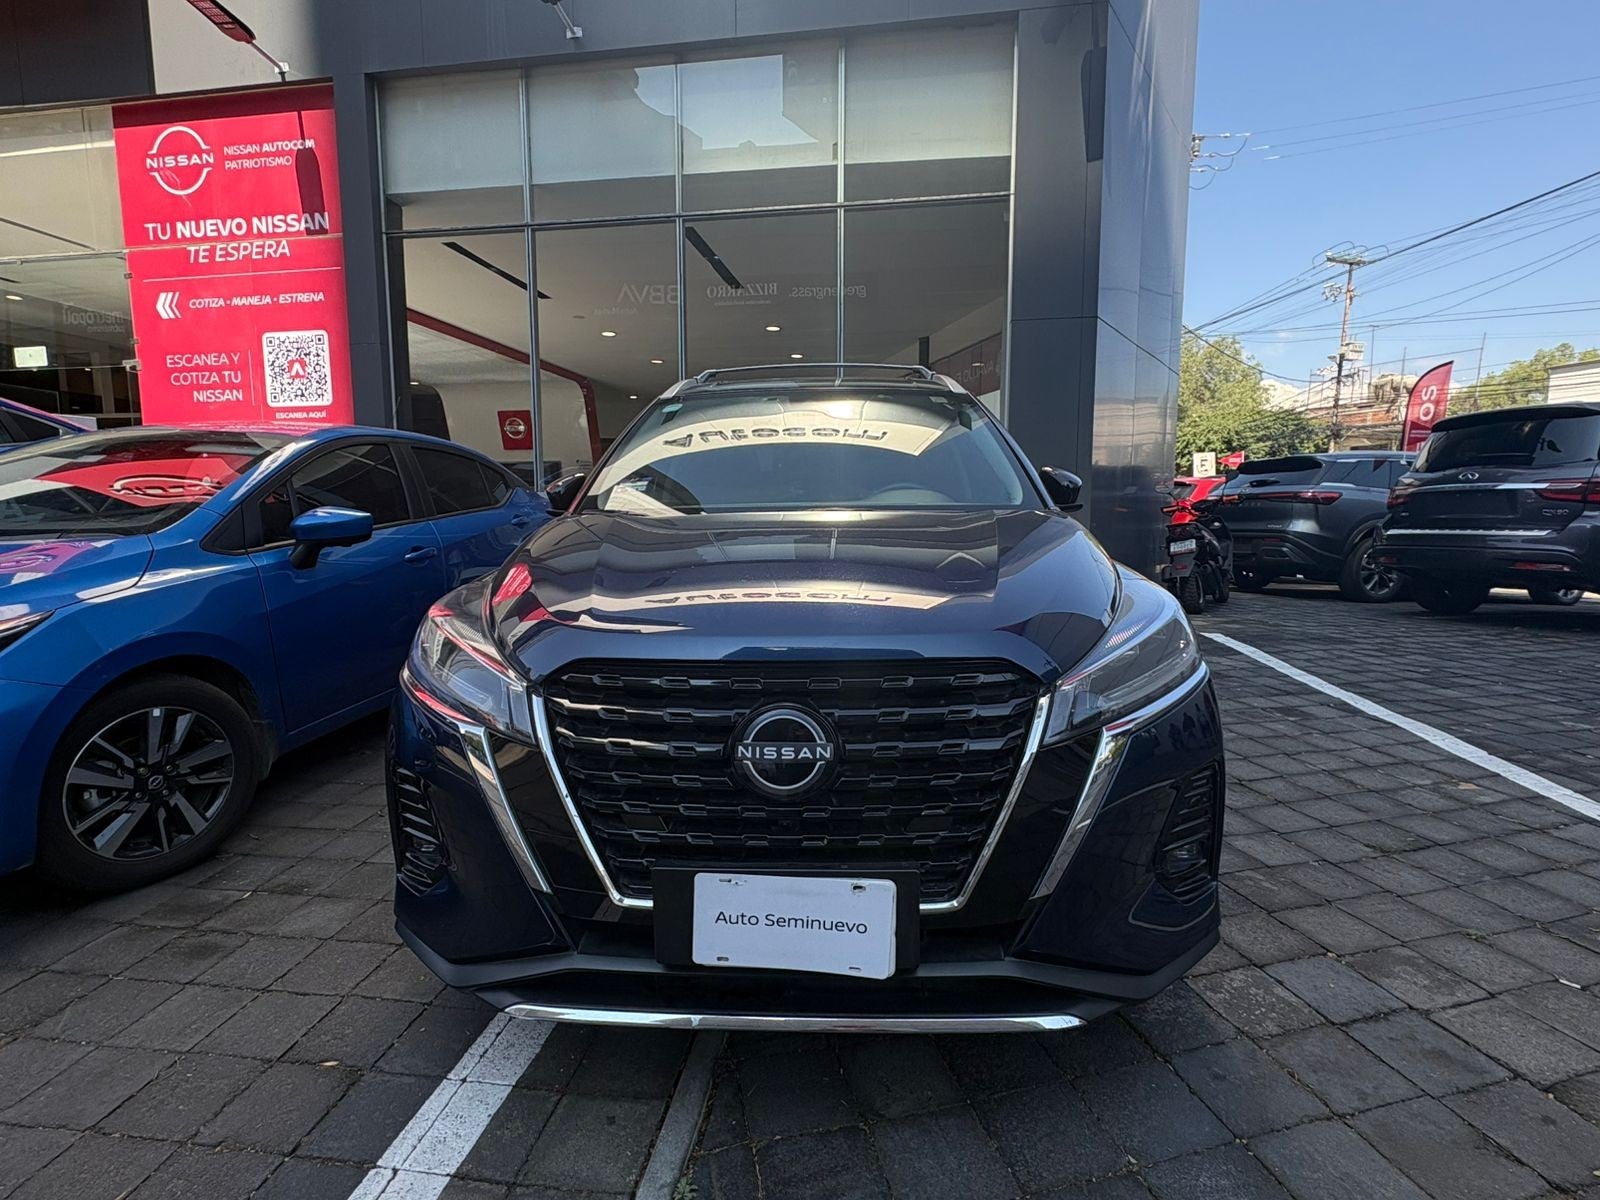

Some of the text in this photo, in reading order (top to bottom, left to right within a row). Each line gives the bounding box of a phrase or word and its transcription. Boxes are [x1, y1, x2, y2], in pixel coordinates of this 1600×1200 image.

[223, 138, 315, 156] NISSAN AUTOCOM
[145, 152, 215, 169] NISSAN
[224, 155, 293, 170] PATRIOTISMO
[143, 211, 329, 241] TU NUEVO NISSAN
[186, 240, 291, 263] TE ESPERA
[189, 291, 325, 309] COTIZA MANEJA ESTRENA
[166, 352, 241, 368] ESCANEA Y
[170, 370, 241, 386] COTIZA TU
[193, 389, 243, 403] NISSAN
[275, 411, 308, 420] ESCANEA
[737, 745, 831, 760] NISSAN
[715, 911, 868, 935] Auto Seminuevo
